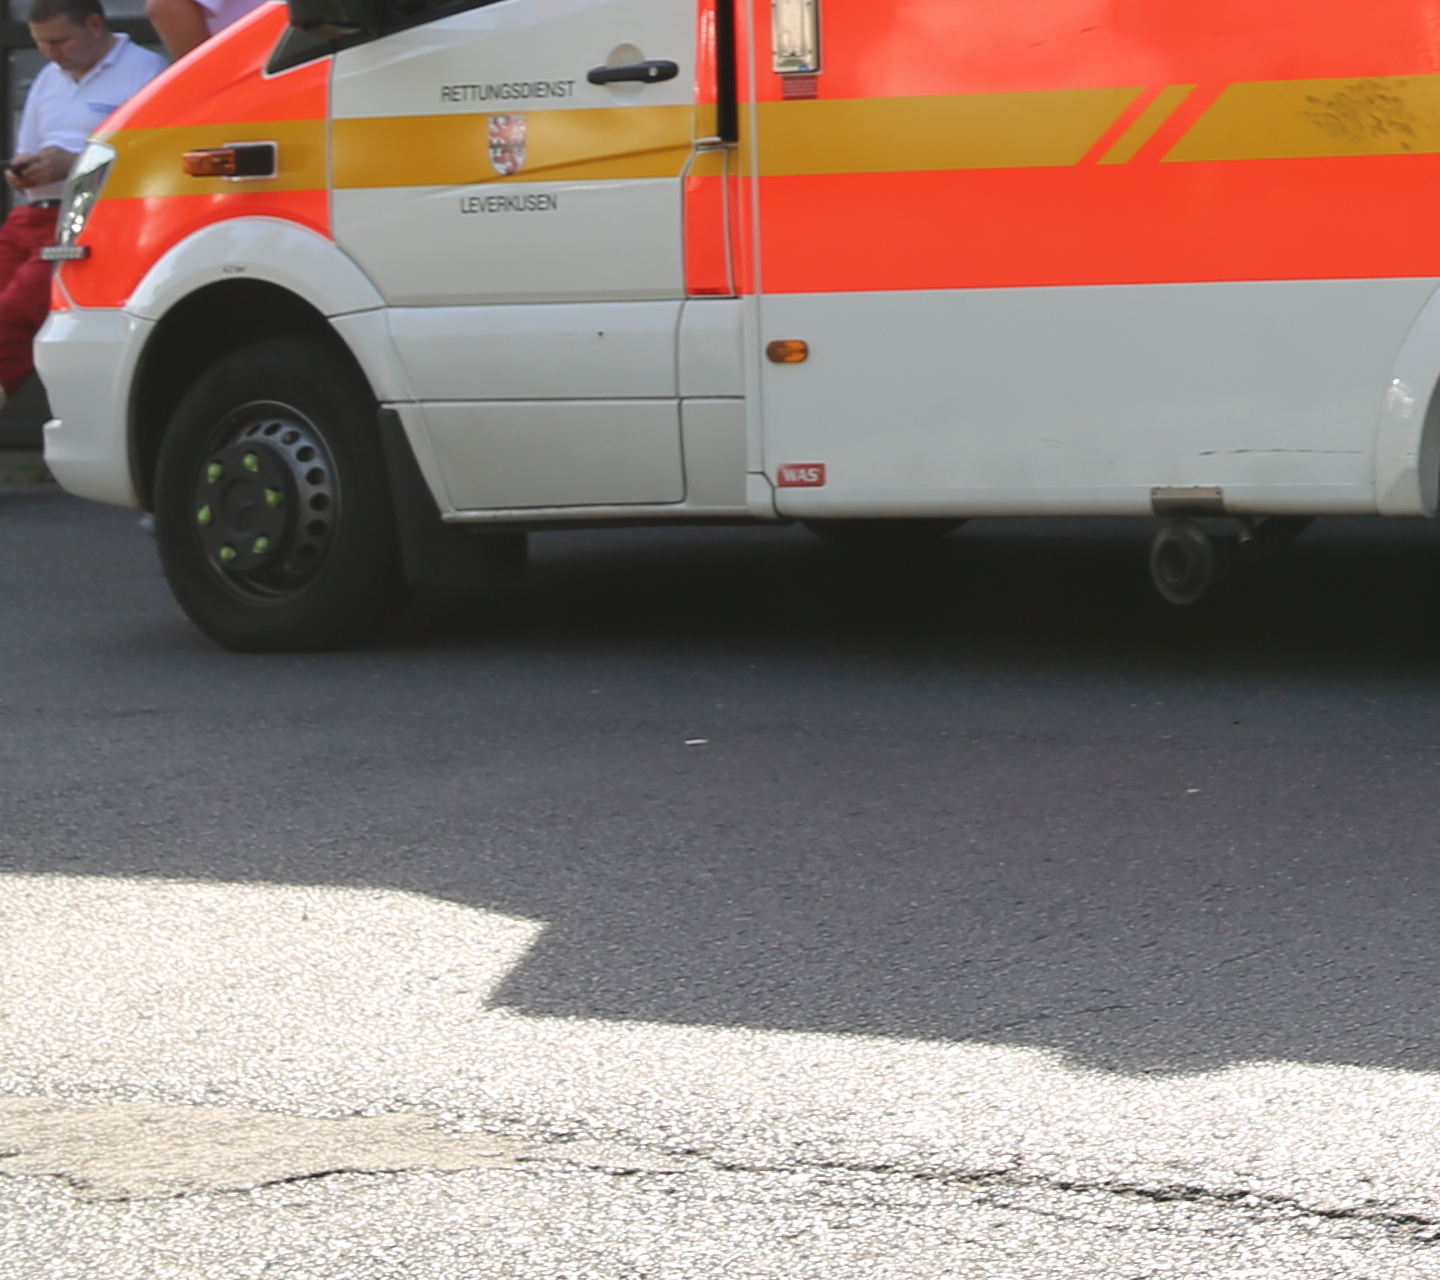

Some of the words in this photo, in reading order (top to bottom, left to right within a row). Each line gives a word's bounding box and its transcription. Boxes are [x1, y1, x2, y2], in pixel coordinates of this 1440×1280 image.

[441, 80, 575, 102] RETTUNGSDIENST
[460, 194, 557, 213] LEVERKUSEN
[783, 468, 819, 482] WAS
